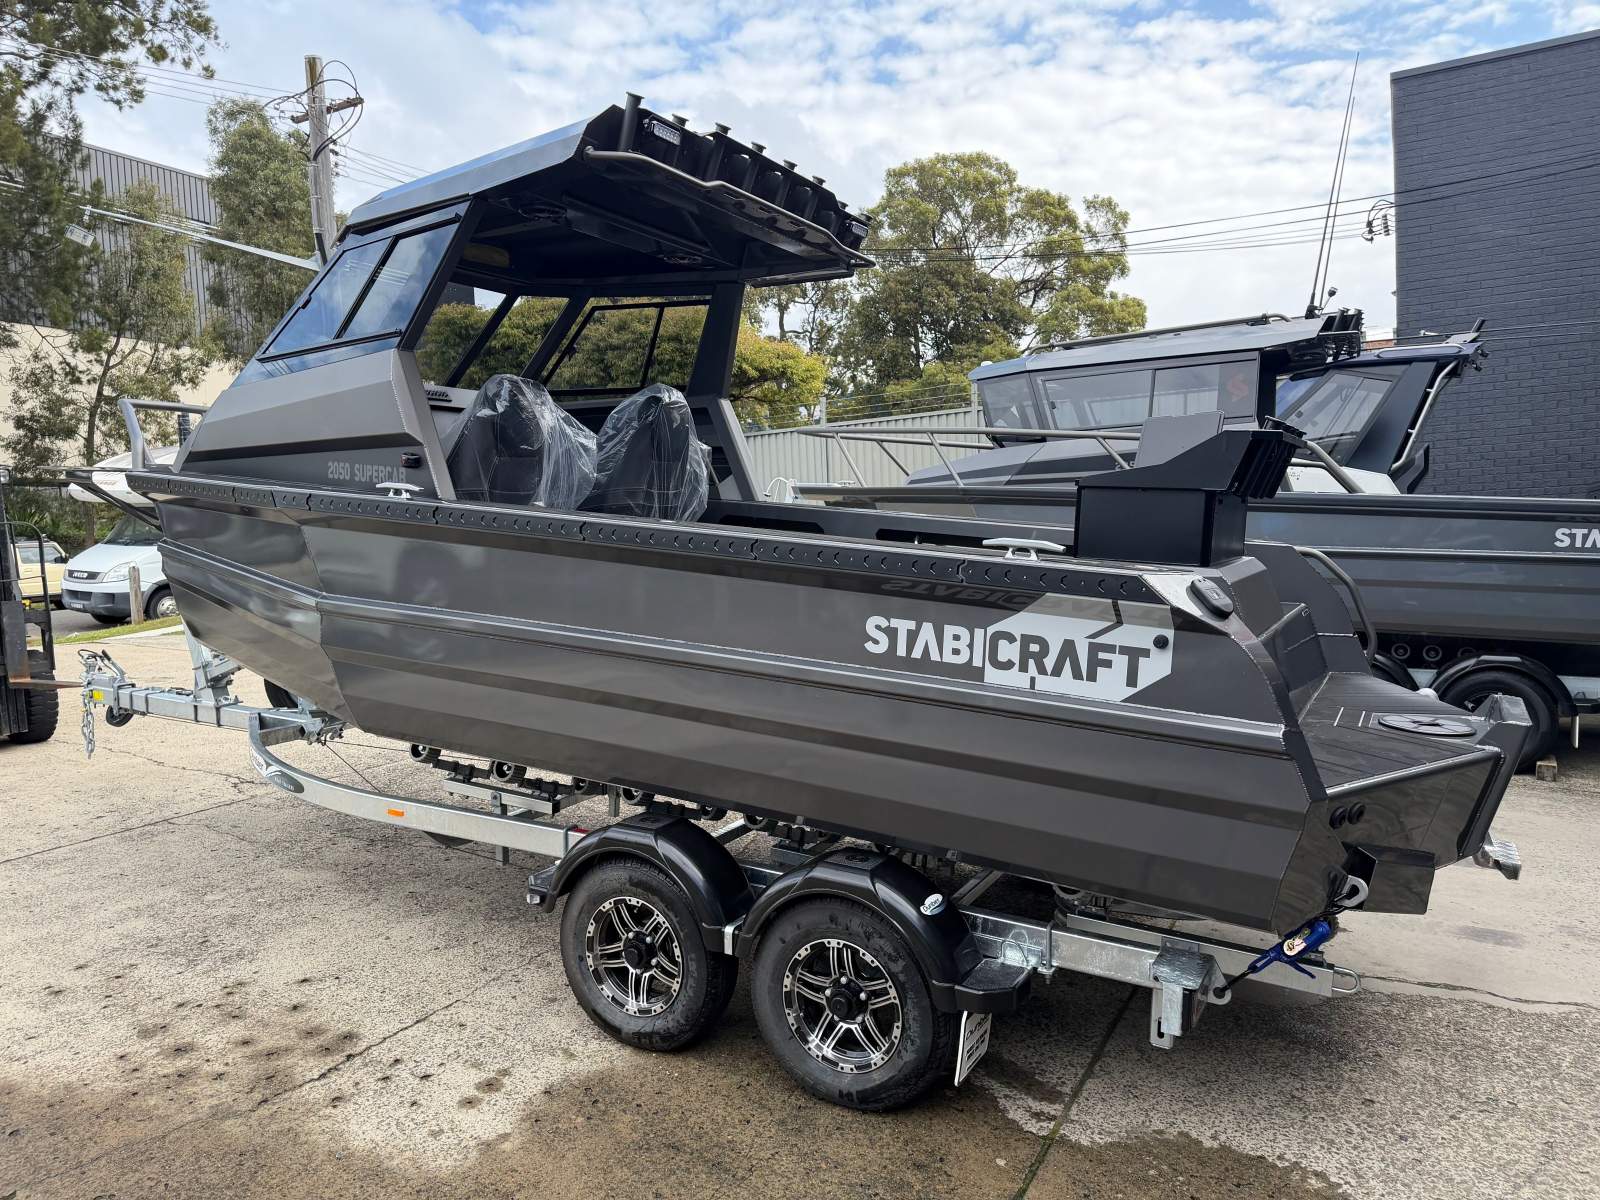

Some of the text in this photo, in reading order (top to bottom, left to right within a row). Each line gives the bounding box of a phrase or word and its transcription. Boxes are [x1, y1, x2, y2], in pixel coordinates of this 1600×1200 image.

[327, 461, 406, 482] 2050 SUPERCAB
[864, 615, 1151, 689] STABICRAFT
